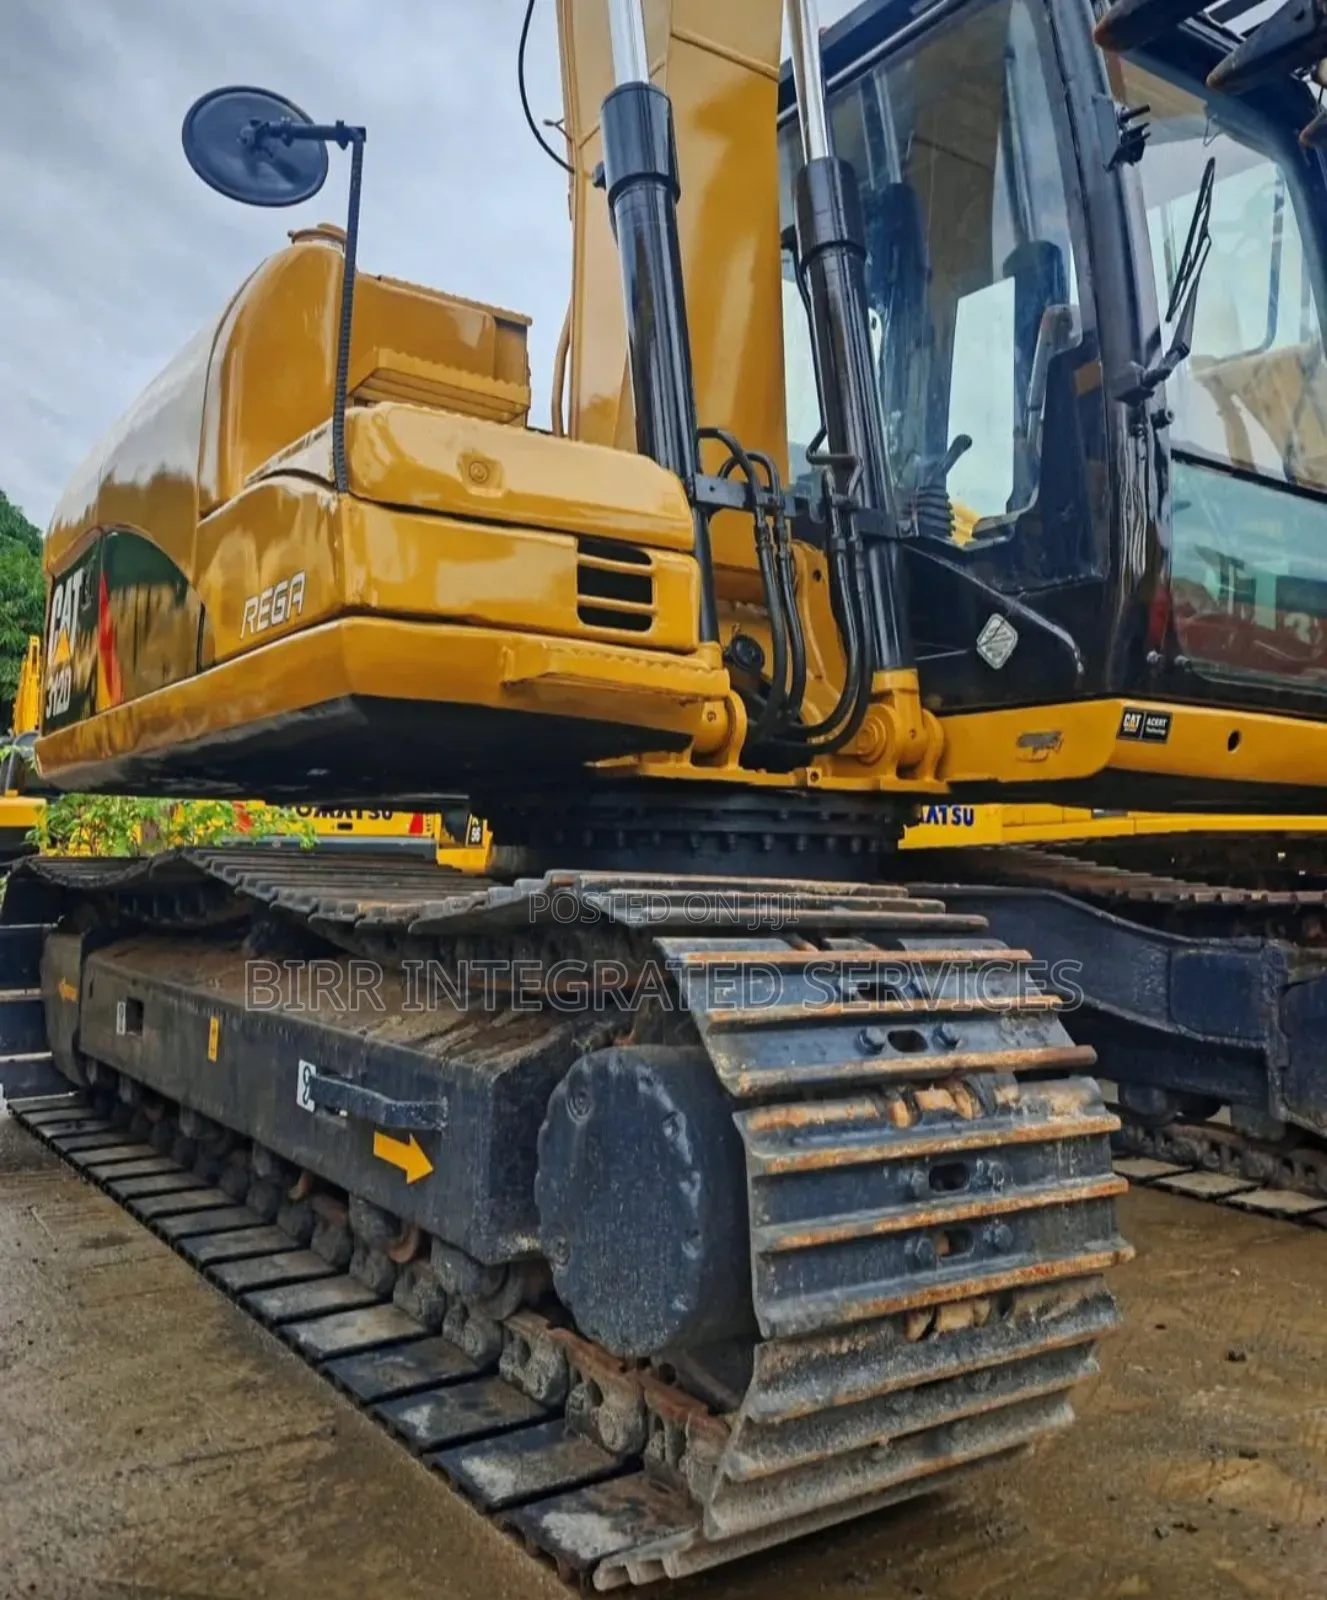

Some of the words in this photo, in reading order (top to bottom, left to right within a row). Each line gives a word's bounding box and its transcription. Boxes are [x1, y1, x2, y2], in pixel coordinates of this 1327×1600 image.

[48, 567, 84, 666] CAT
[240, 571, 306, 640] REGA
[1123, 713, 1142, 728] CAT
